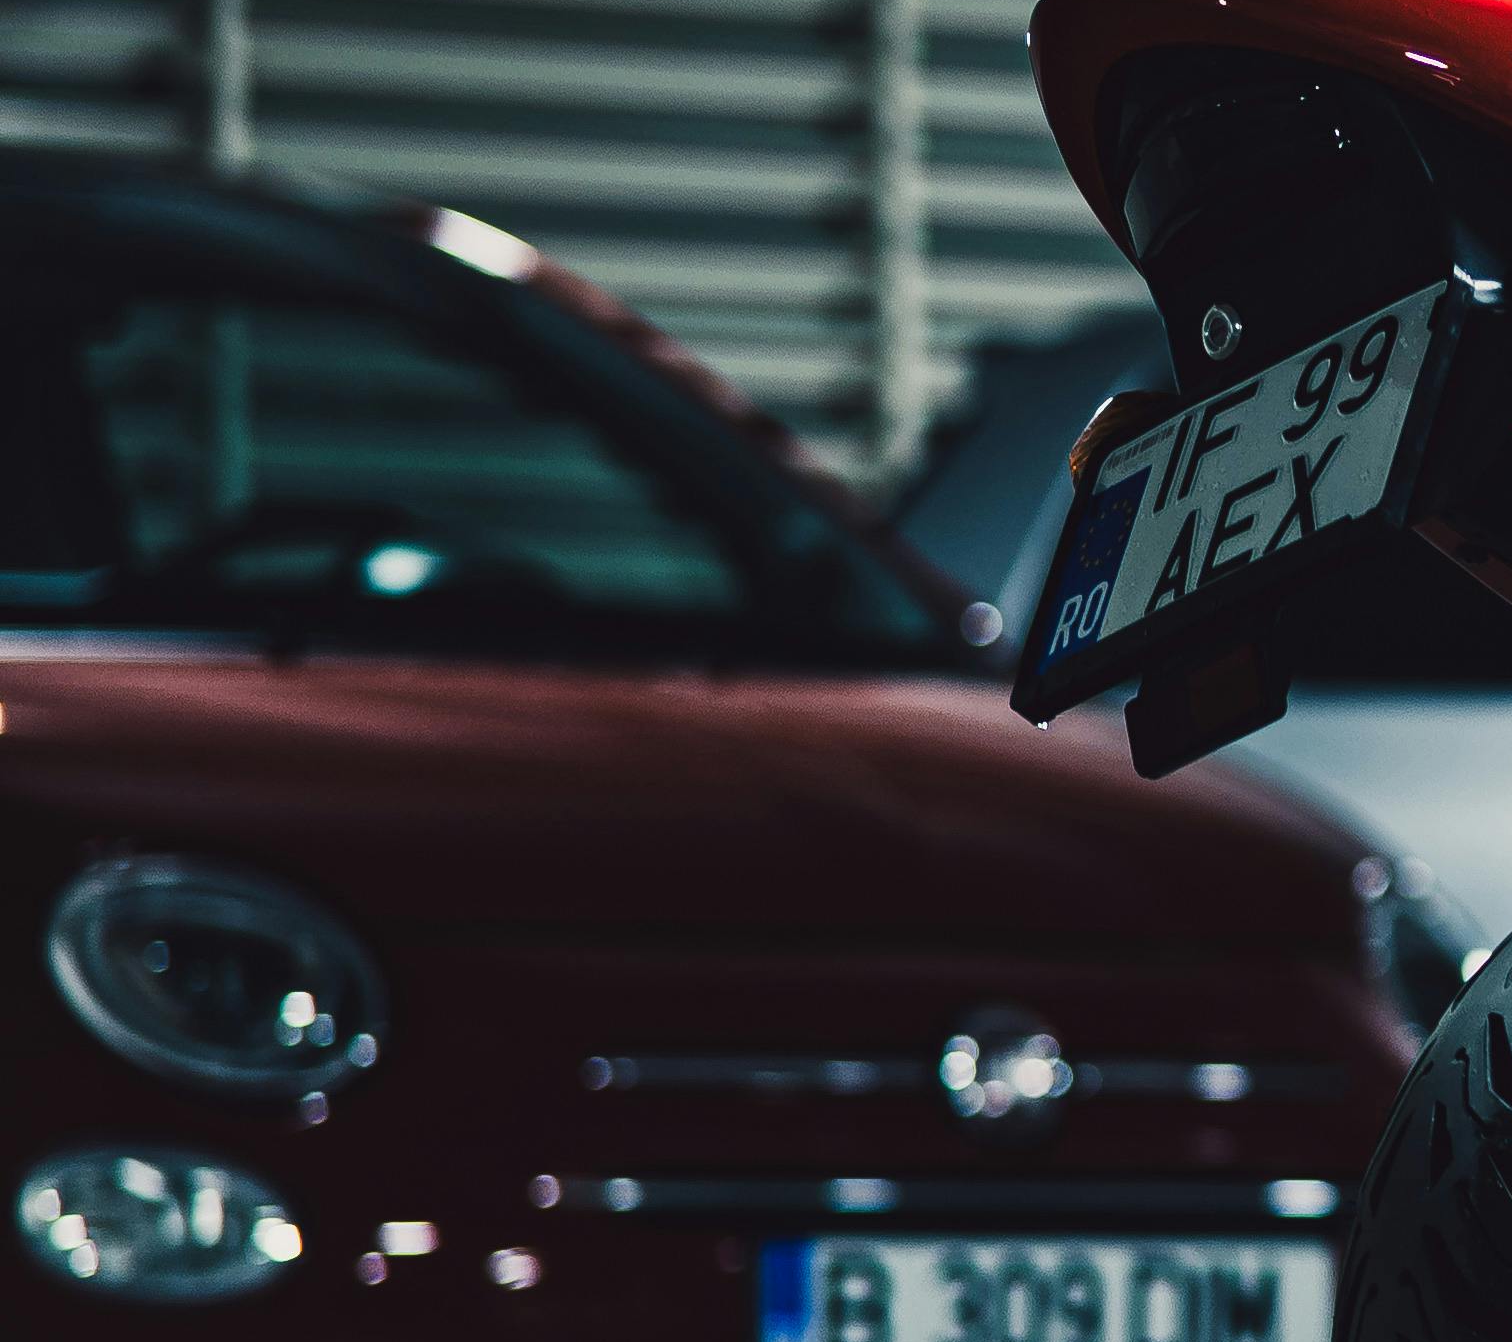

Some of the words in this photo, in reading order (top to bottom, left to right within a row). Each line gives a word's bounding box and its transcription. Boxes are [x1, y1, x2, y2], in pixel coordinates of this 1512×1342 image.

[1153, 378, 1263, 515] IF
[1281, 315, 1400, 444] 99
[1144, 434, 1344, 616] AEX
[1049, 581, 1108, 656] RO
